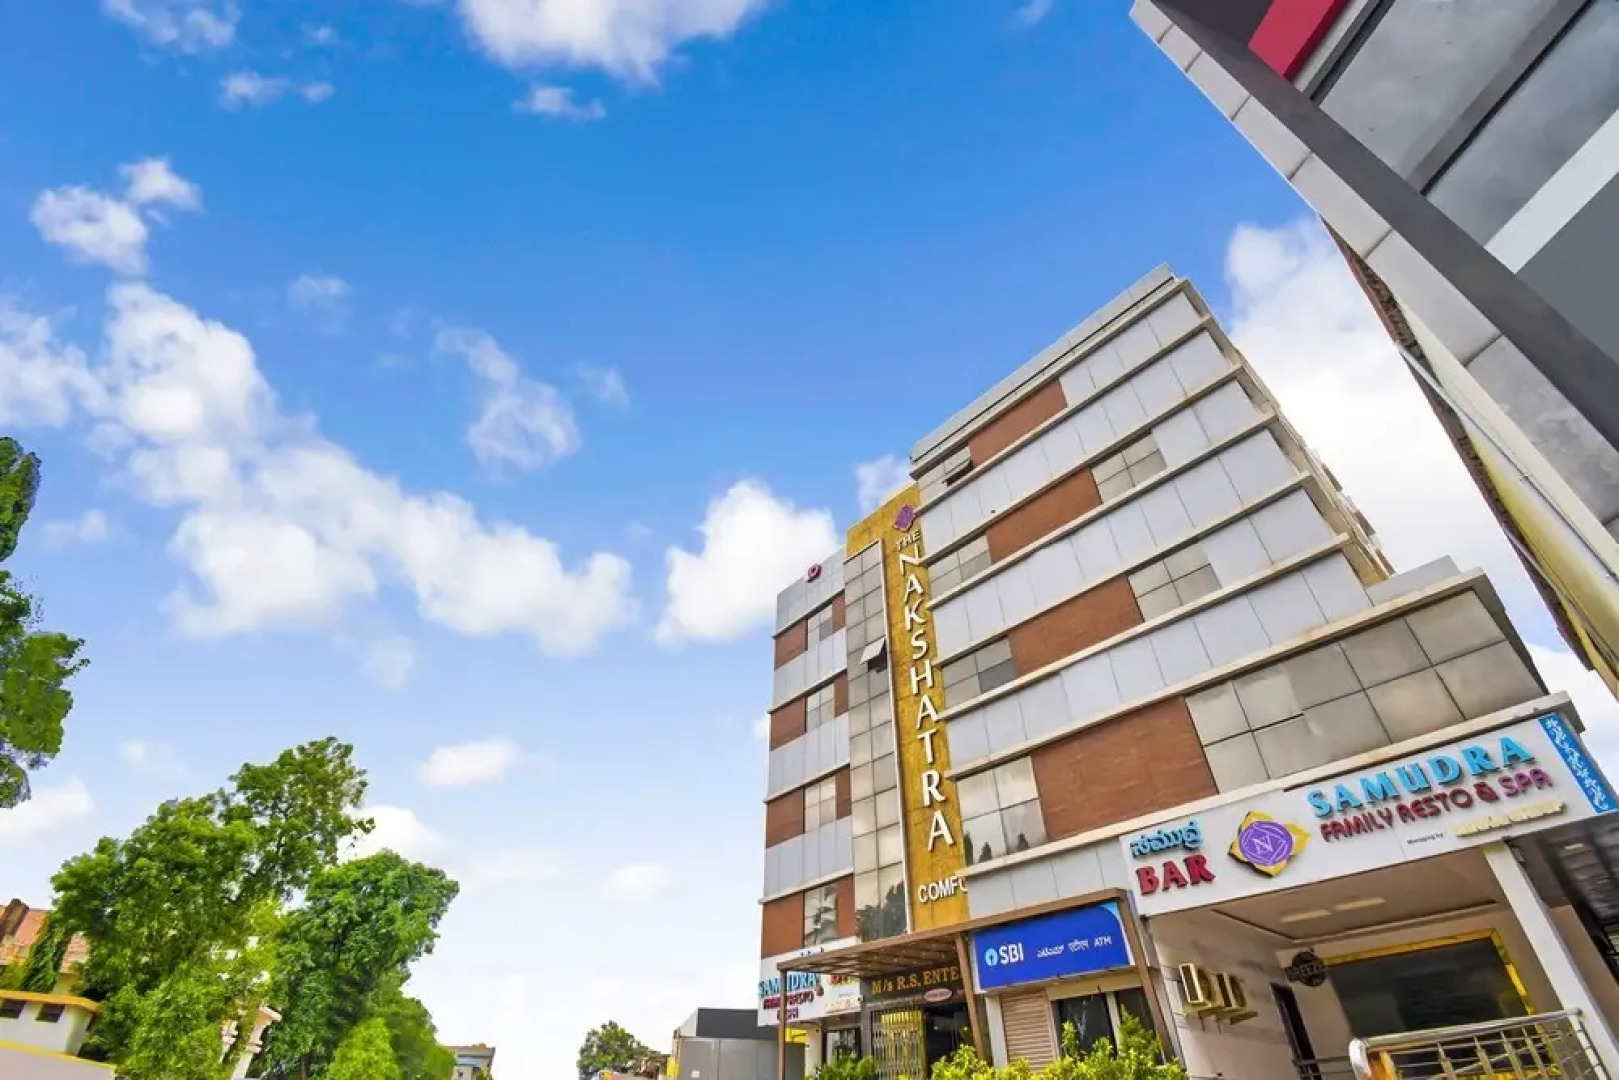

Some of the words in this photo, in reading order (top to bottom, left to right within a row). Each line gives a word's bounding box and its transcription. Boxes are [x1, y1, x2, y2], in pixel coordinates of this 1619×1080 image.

[895, 529, 920, 550] THE
[899, 543, 956, 853] NAKSHATRA
[1306, 736, 1536, 819] SAMUDRA
[1320, 807, 1394, 843] FAMILY
[1396, 787, 1473, 823] RESTO
[1499, 768, 1553, 798] SPA
[1136, 854, 1216, 896] BAR
[998, 942, 1024, 965] SBI
[1093, 936, 1113, 948] ATM
[922, 966, 960, 985] ENTE
